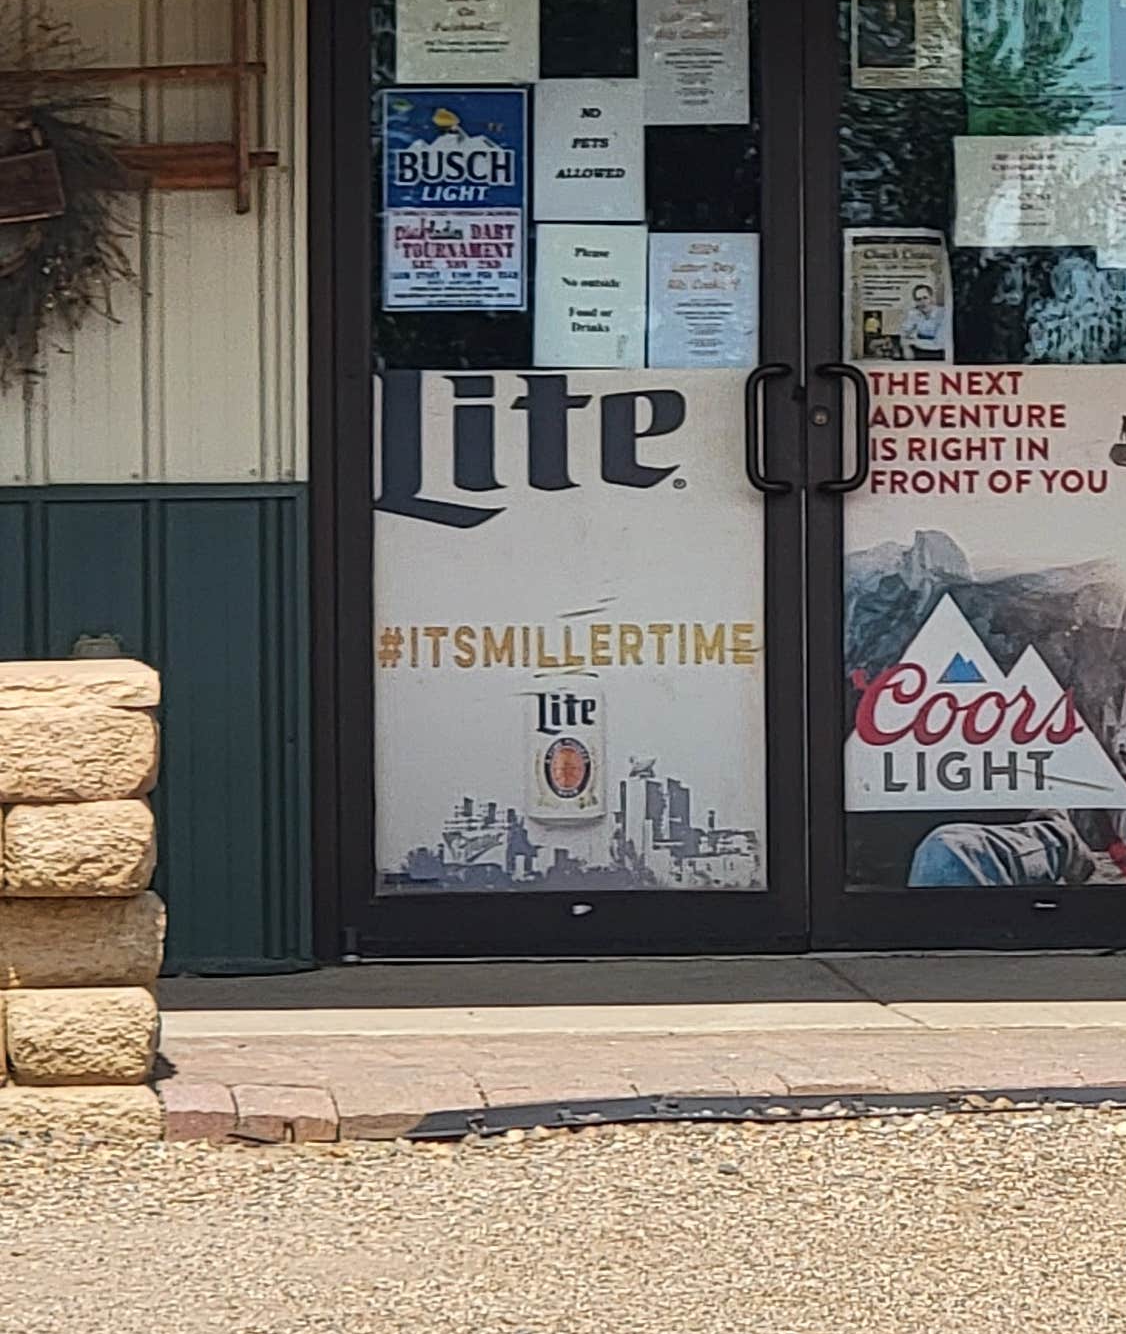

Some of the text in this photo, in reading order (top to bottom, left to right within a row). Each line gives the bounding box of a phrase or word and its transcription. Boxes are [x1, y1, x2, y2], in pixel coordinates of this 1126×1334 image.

[580, 108, 602, 118] NO
[572, 138, 609, 148] PETS
[397, 150, 514, 184] BUSCH
[555, 168, 626, 178] ALLOWED
[421, 186, 489, 201] LIGHT
[402, 242, 514, 258] TOURNAMENT
[870, 371, 1024, 395] THE NEXT
[870, 404, 1067, 428] ADVENTURE
[373, 370, 686, 528] Lite
[871, 437, 1050, 462] IS RIGHT IN
[870, 470, 1108, 494] FRONT OF YOU
[377, 623, 757, 667] #ITSMILLERTIME
[536, 693, 597, 735] Lite
[851, 662, 1084, 746] Coors
[883, 751, 1054, 792] LIGHT
